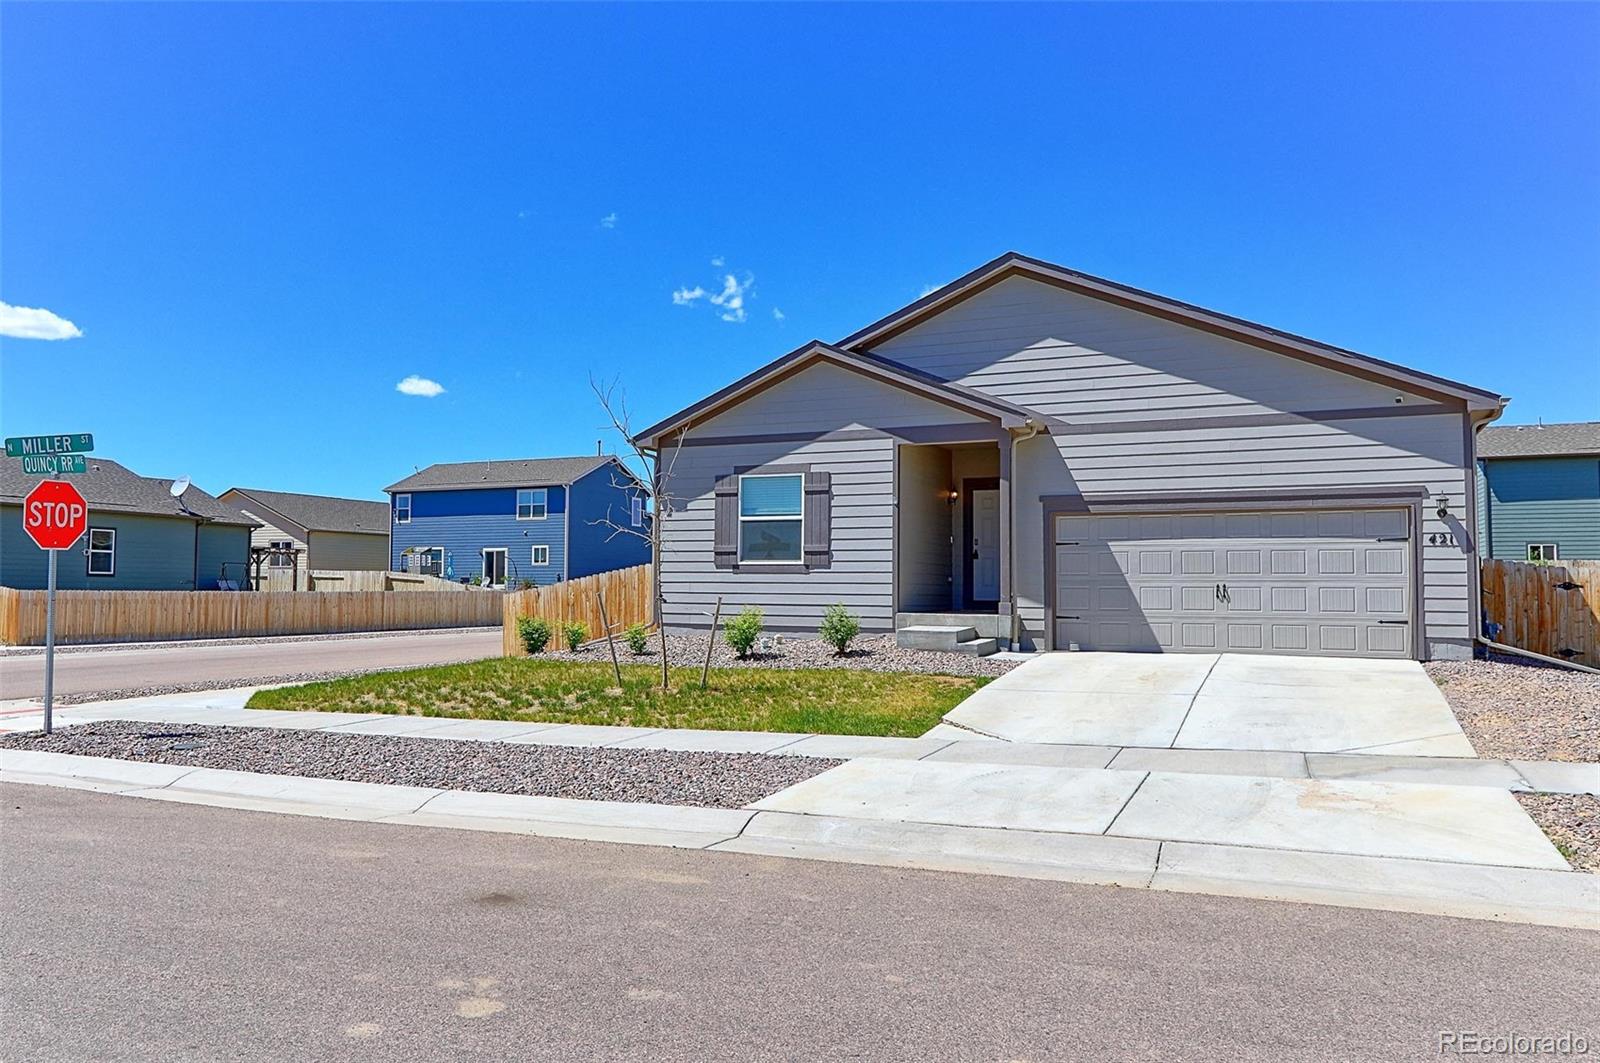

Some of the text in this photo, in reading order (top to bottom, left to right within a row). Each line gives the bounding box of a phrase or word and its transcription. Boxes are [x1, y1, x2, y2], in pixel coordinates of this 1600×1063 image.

[7, 435, 89, 454] N MILLER ST
[24, 456, 84, 473] QUINCY RR AVE
[29, 501, 83, 528] STOP
[1429, 533, 1454, 546] 421
